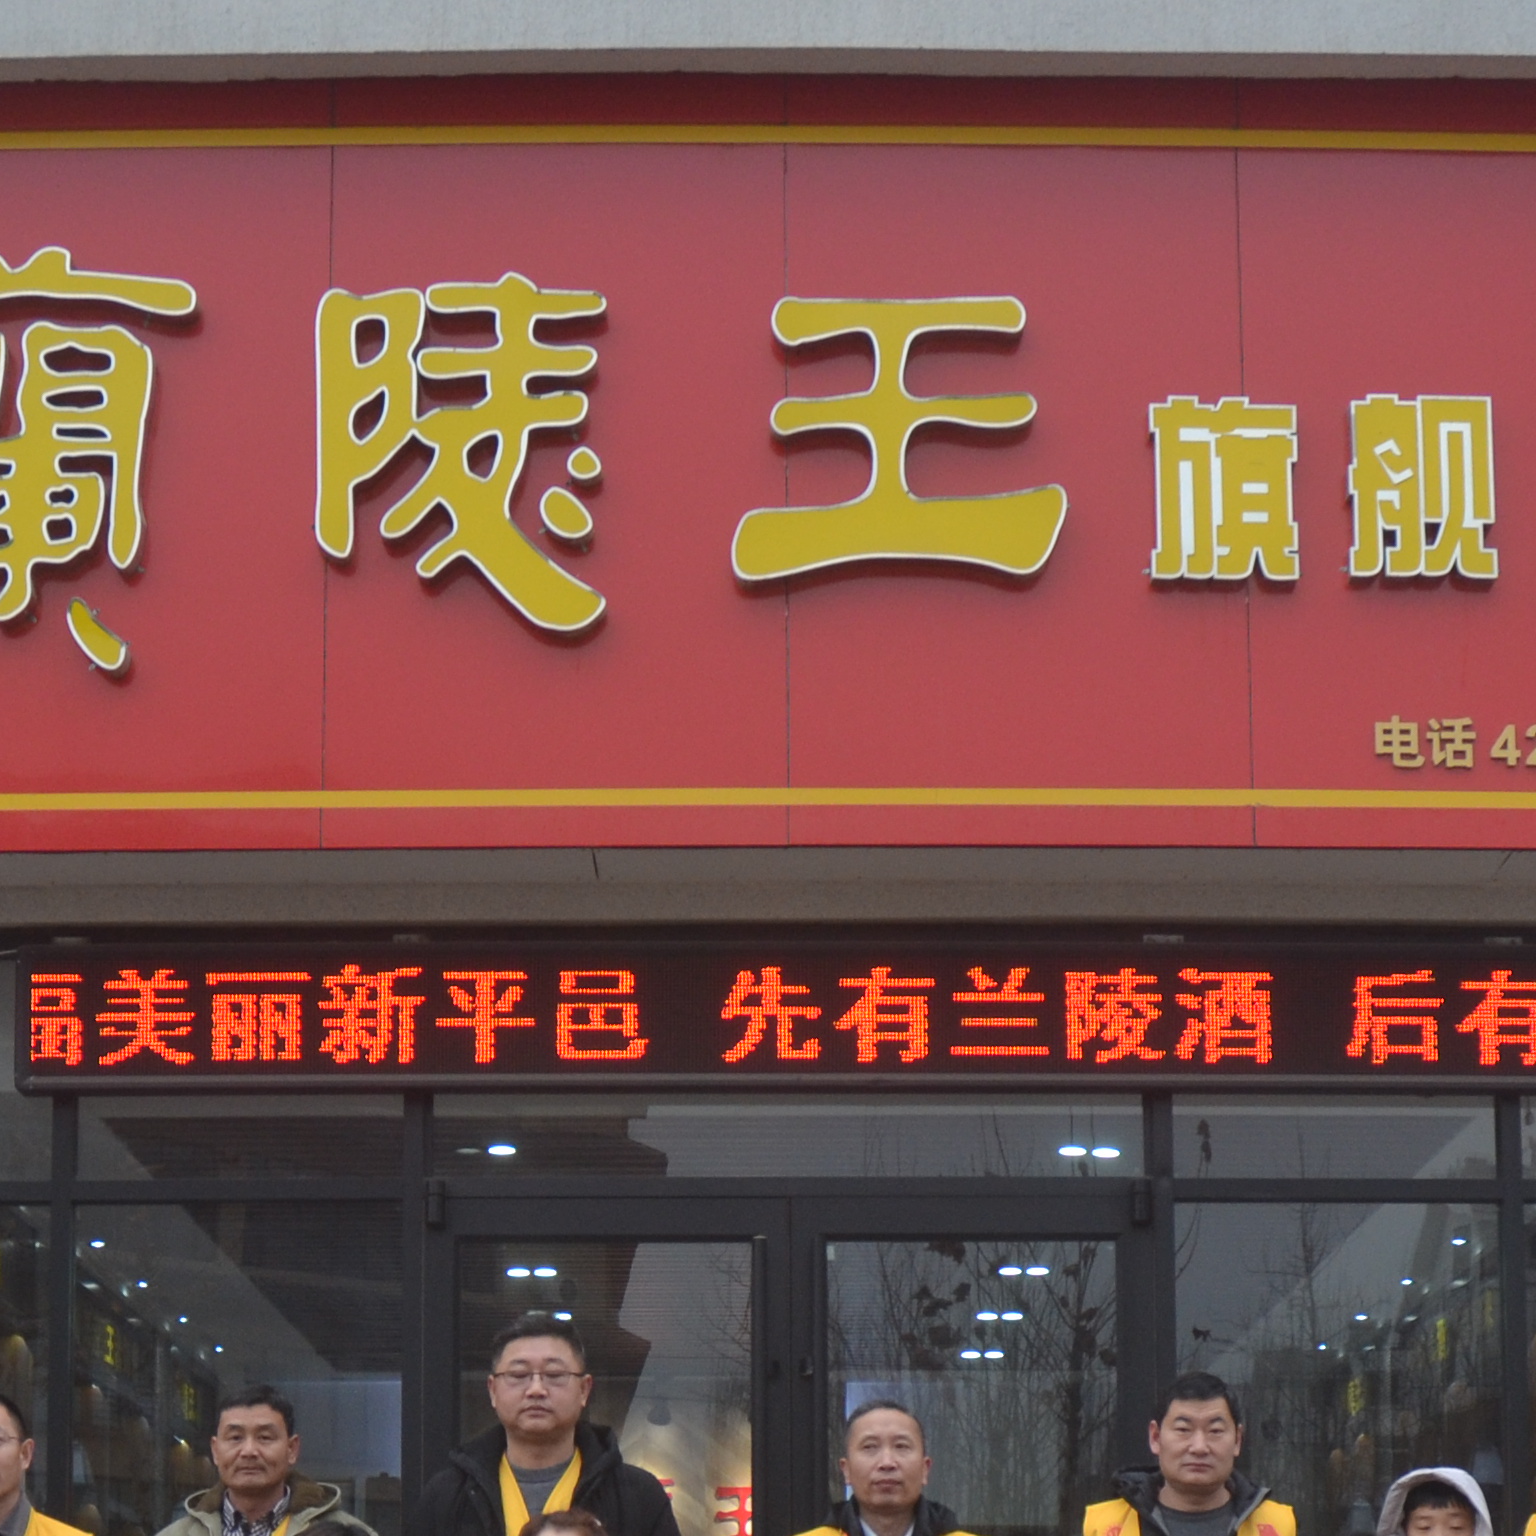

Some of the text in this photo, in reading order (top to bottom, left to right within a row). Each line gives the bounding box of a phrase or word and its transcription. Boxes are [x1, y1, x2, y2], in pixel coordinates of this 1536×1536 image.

[1374, 715, 1477, 768] 电话
[720, 966, 1274, 1065] 先有兰陵酒
